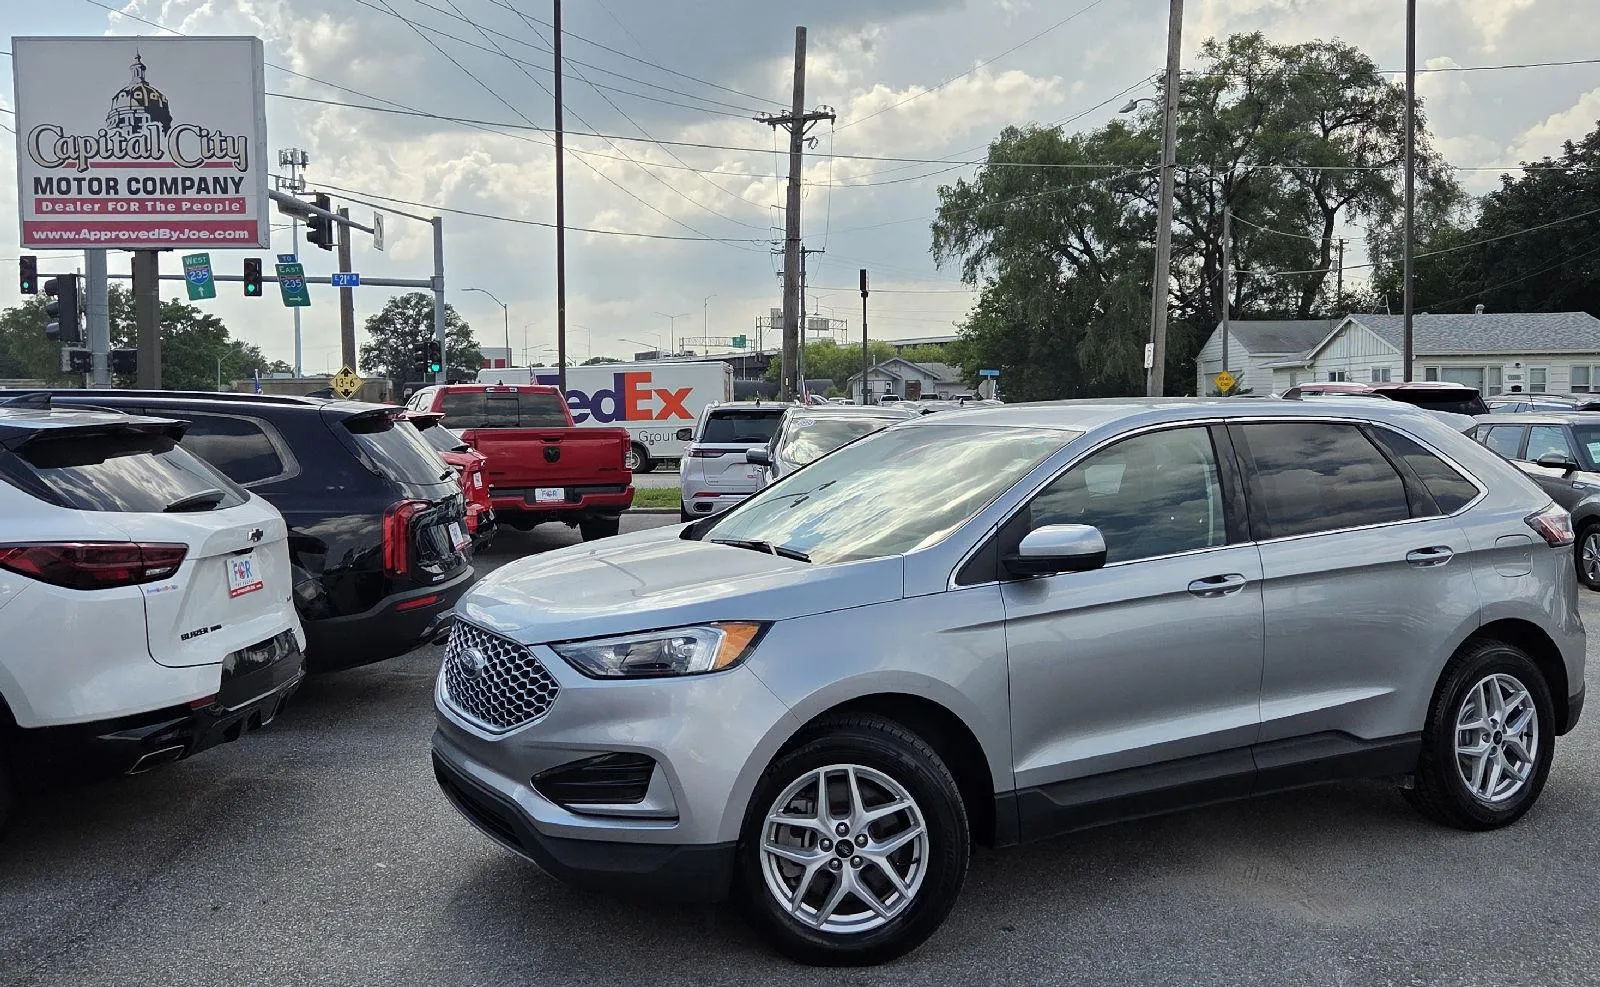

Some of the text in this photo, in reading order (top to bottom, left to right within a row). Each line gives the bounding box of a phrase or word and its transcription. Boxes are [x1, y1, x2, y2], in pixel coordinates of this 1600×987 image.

[28, 124, 248, 173] Capital City
[33, 176, 245, 196] MOTOR COMPANY
[41, 200, 240, 213] Dealer FOR The People
[33, 228, 249, 241] www.ApprovedByJoe.com
[185, 256, 207, 265] WEST
[189, 269, 209, 281] 235
[279, 265, 300, 273] EAST
[284, 279, 302, 289] 235
[536, 371, 694, 423] edEx
[638, 430, 678, 442] Groun
